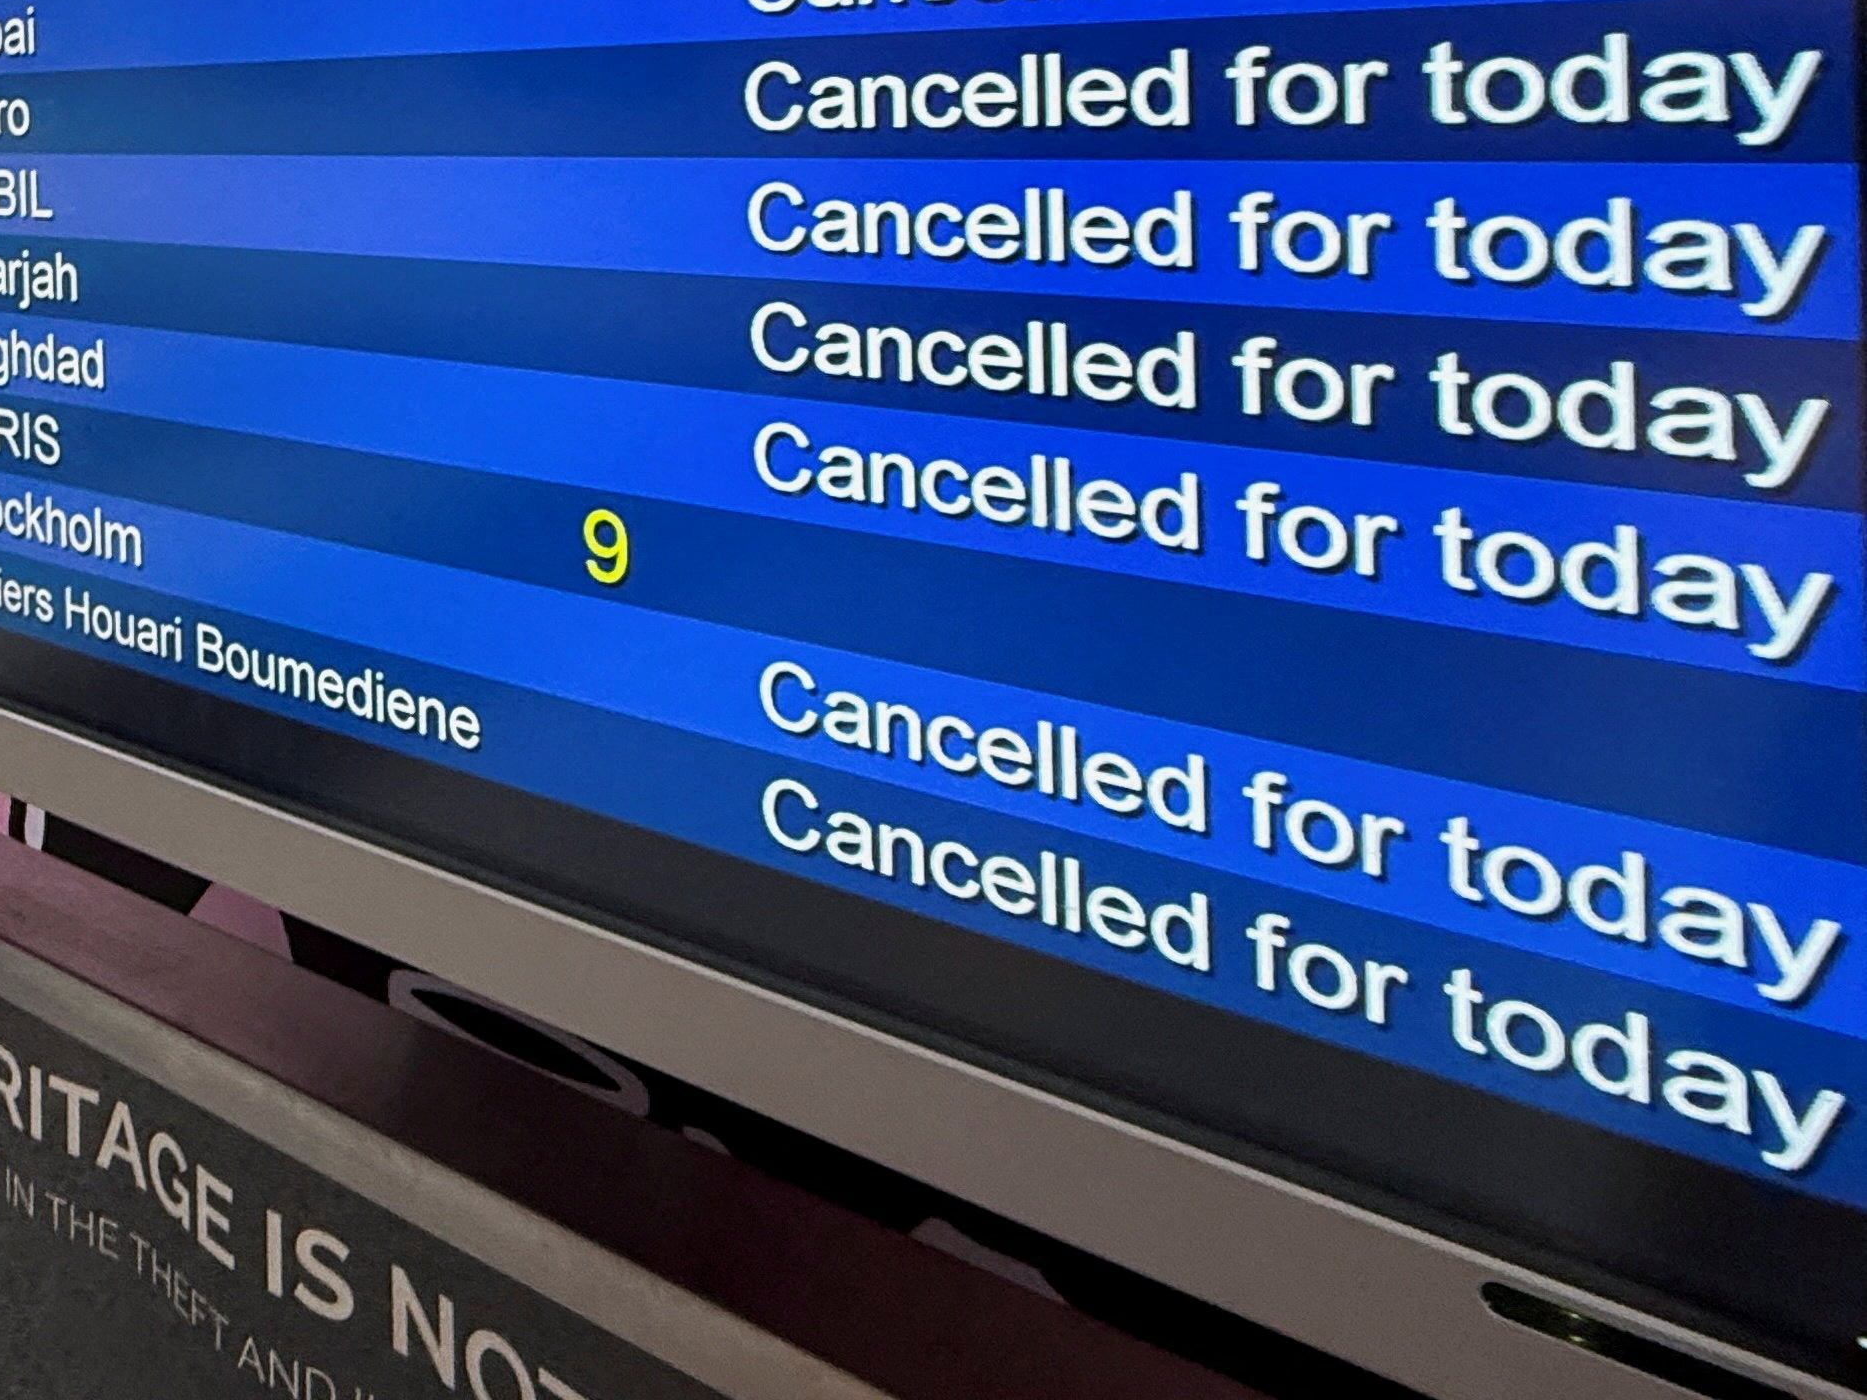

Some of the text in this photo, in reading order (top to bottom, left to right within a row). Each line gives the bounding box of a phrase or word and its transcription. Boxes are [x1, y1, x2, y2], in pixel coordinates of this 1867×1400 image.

[745, 33, 1821, 145] Cancelled for today
[748, 182, 1824, 316] Cancelled for today
[751, 302, 1829, 487] Cancelled for today
[584, 509, 627, 583] 9
[754, 422, 1831, 658] Cancelled for today
[66, 587, 182, 661] Houari
[197, 623, 480, 748] Boumediene
[760, 662, 1841, 1000] Cancelled for today
[763, 779, 1845, 1170] Cancelled for today
[5, 1167, 36, 1217] IN
[45, 1191, 118, 1260] THE
[130, 1232, 230, 1351] THEFT
[266, 1209, 354, 1322] IS
